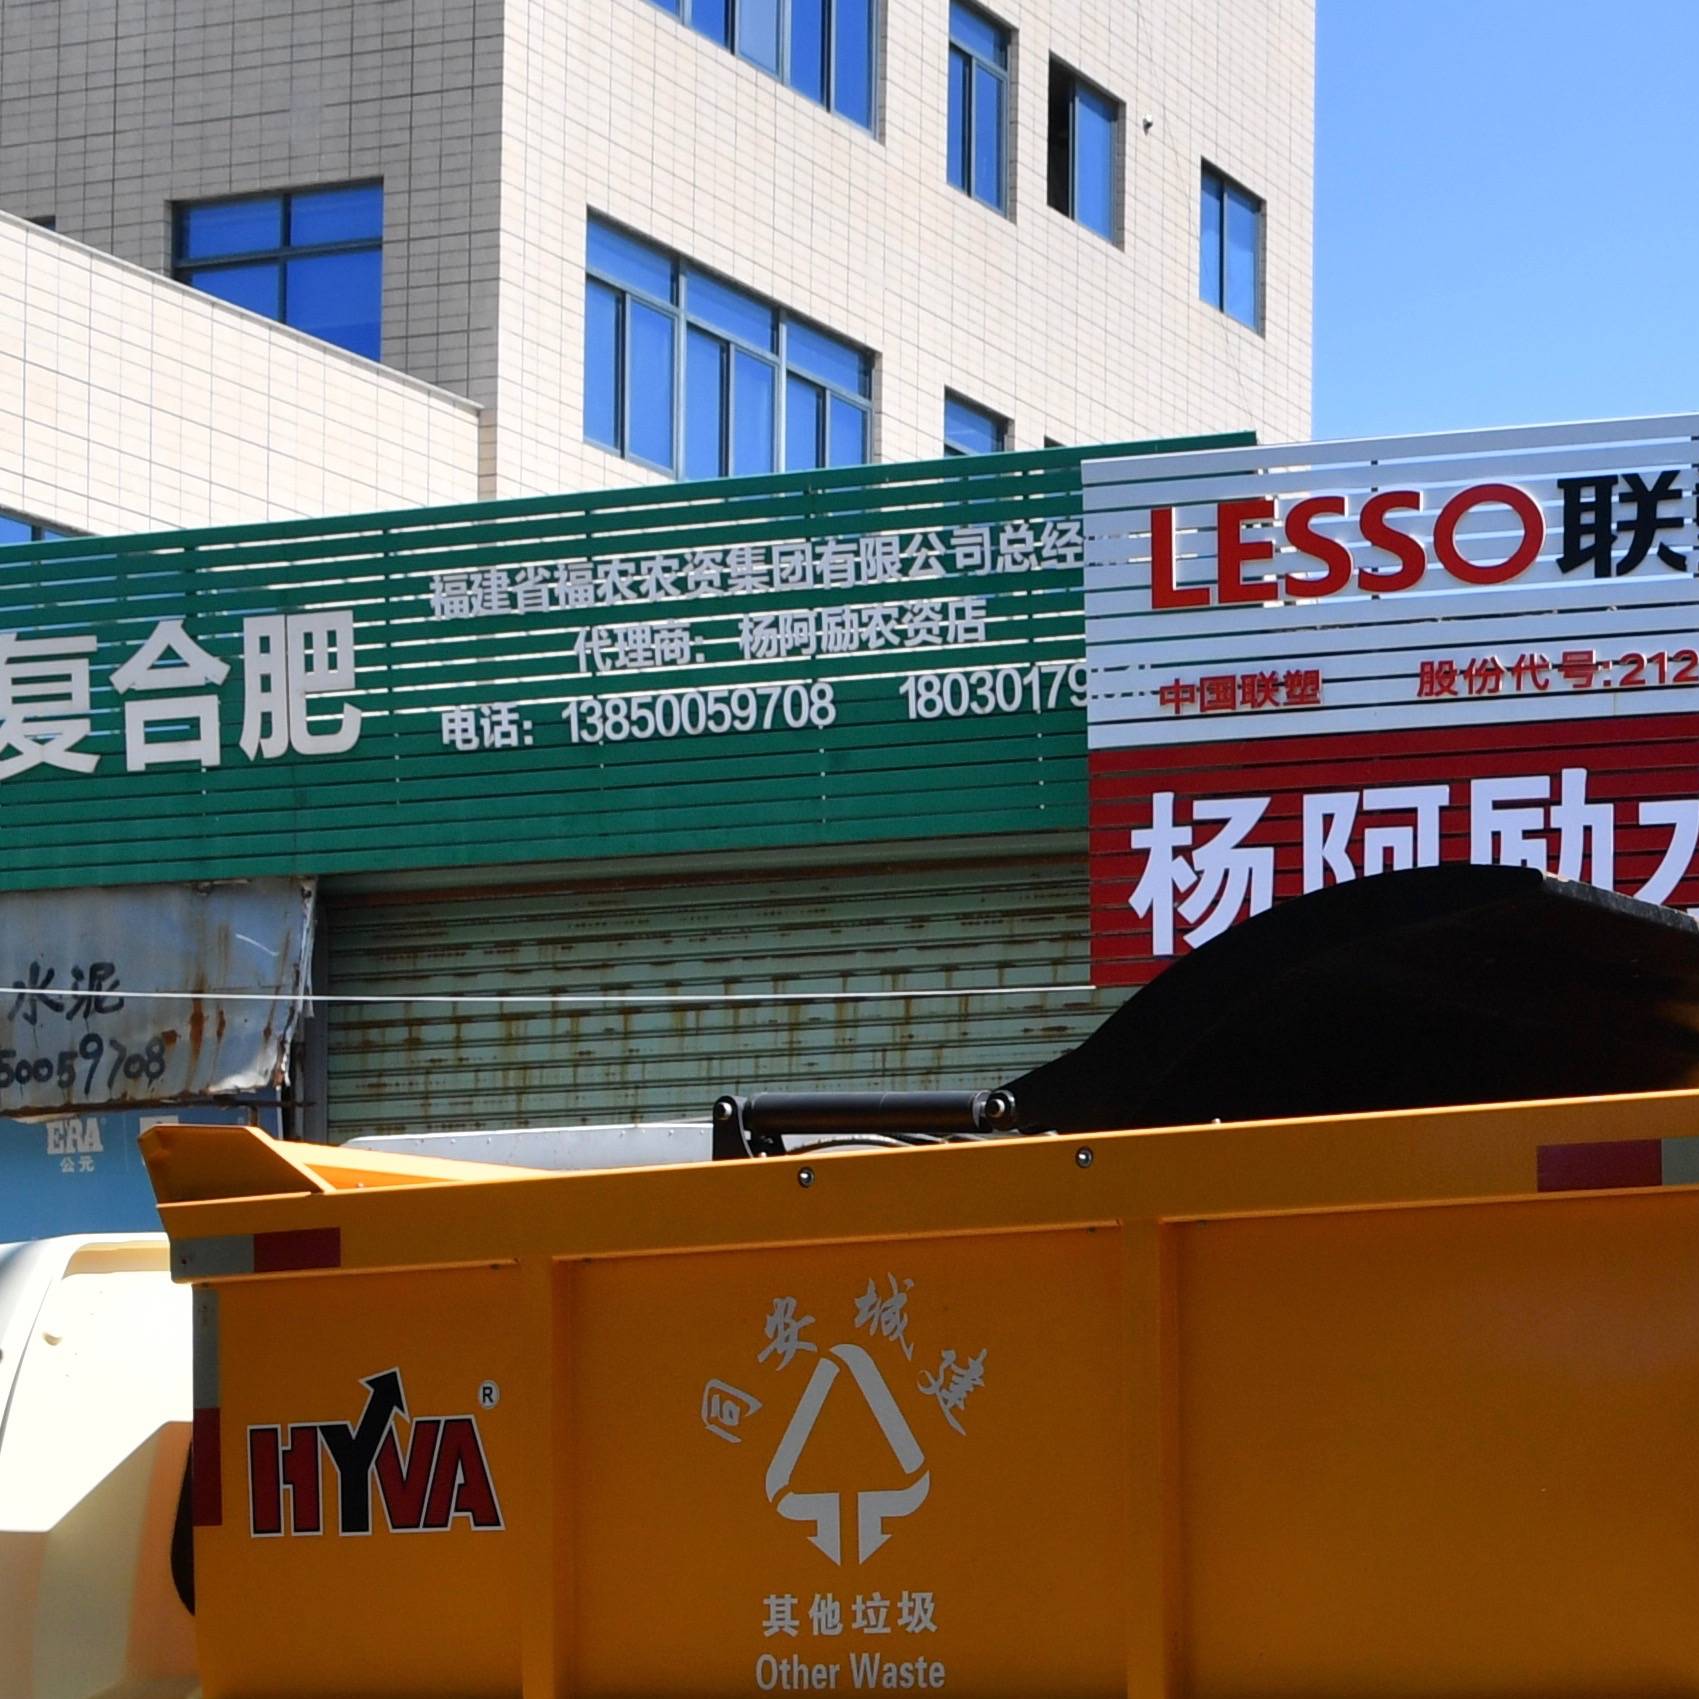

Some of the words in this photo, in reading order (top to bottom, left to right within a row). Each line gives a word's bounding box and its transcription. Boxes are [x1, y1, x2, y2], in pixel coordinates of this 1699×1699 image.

[1149, 483, 1547, 609] LESSO
[0, 609, 362, 781] 复合肥
[1158, 667, 1322, 714] 中国联塑
[8, 960, 125, 1026] 水泥
[47, 1116, 104, 1155] ERA
[60, 1155, 95, 1173] 公元
[247, 1366, 506, 1538] HYVA
[761, 1591, 939, 1638] 其他垃圾
[755, 1653, 841, 1691] Other
[849, 1652, 946, 1690] Waste
